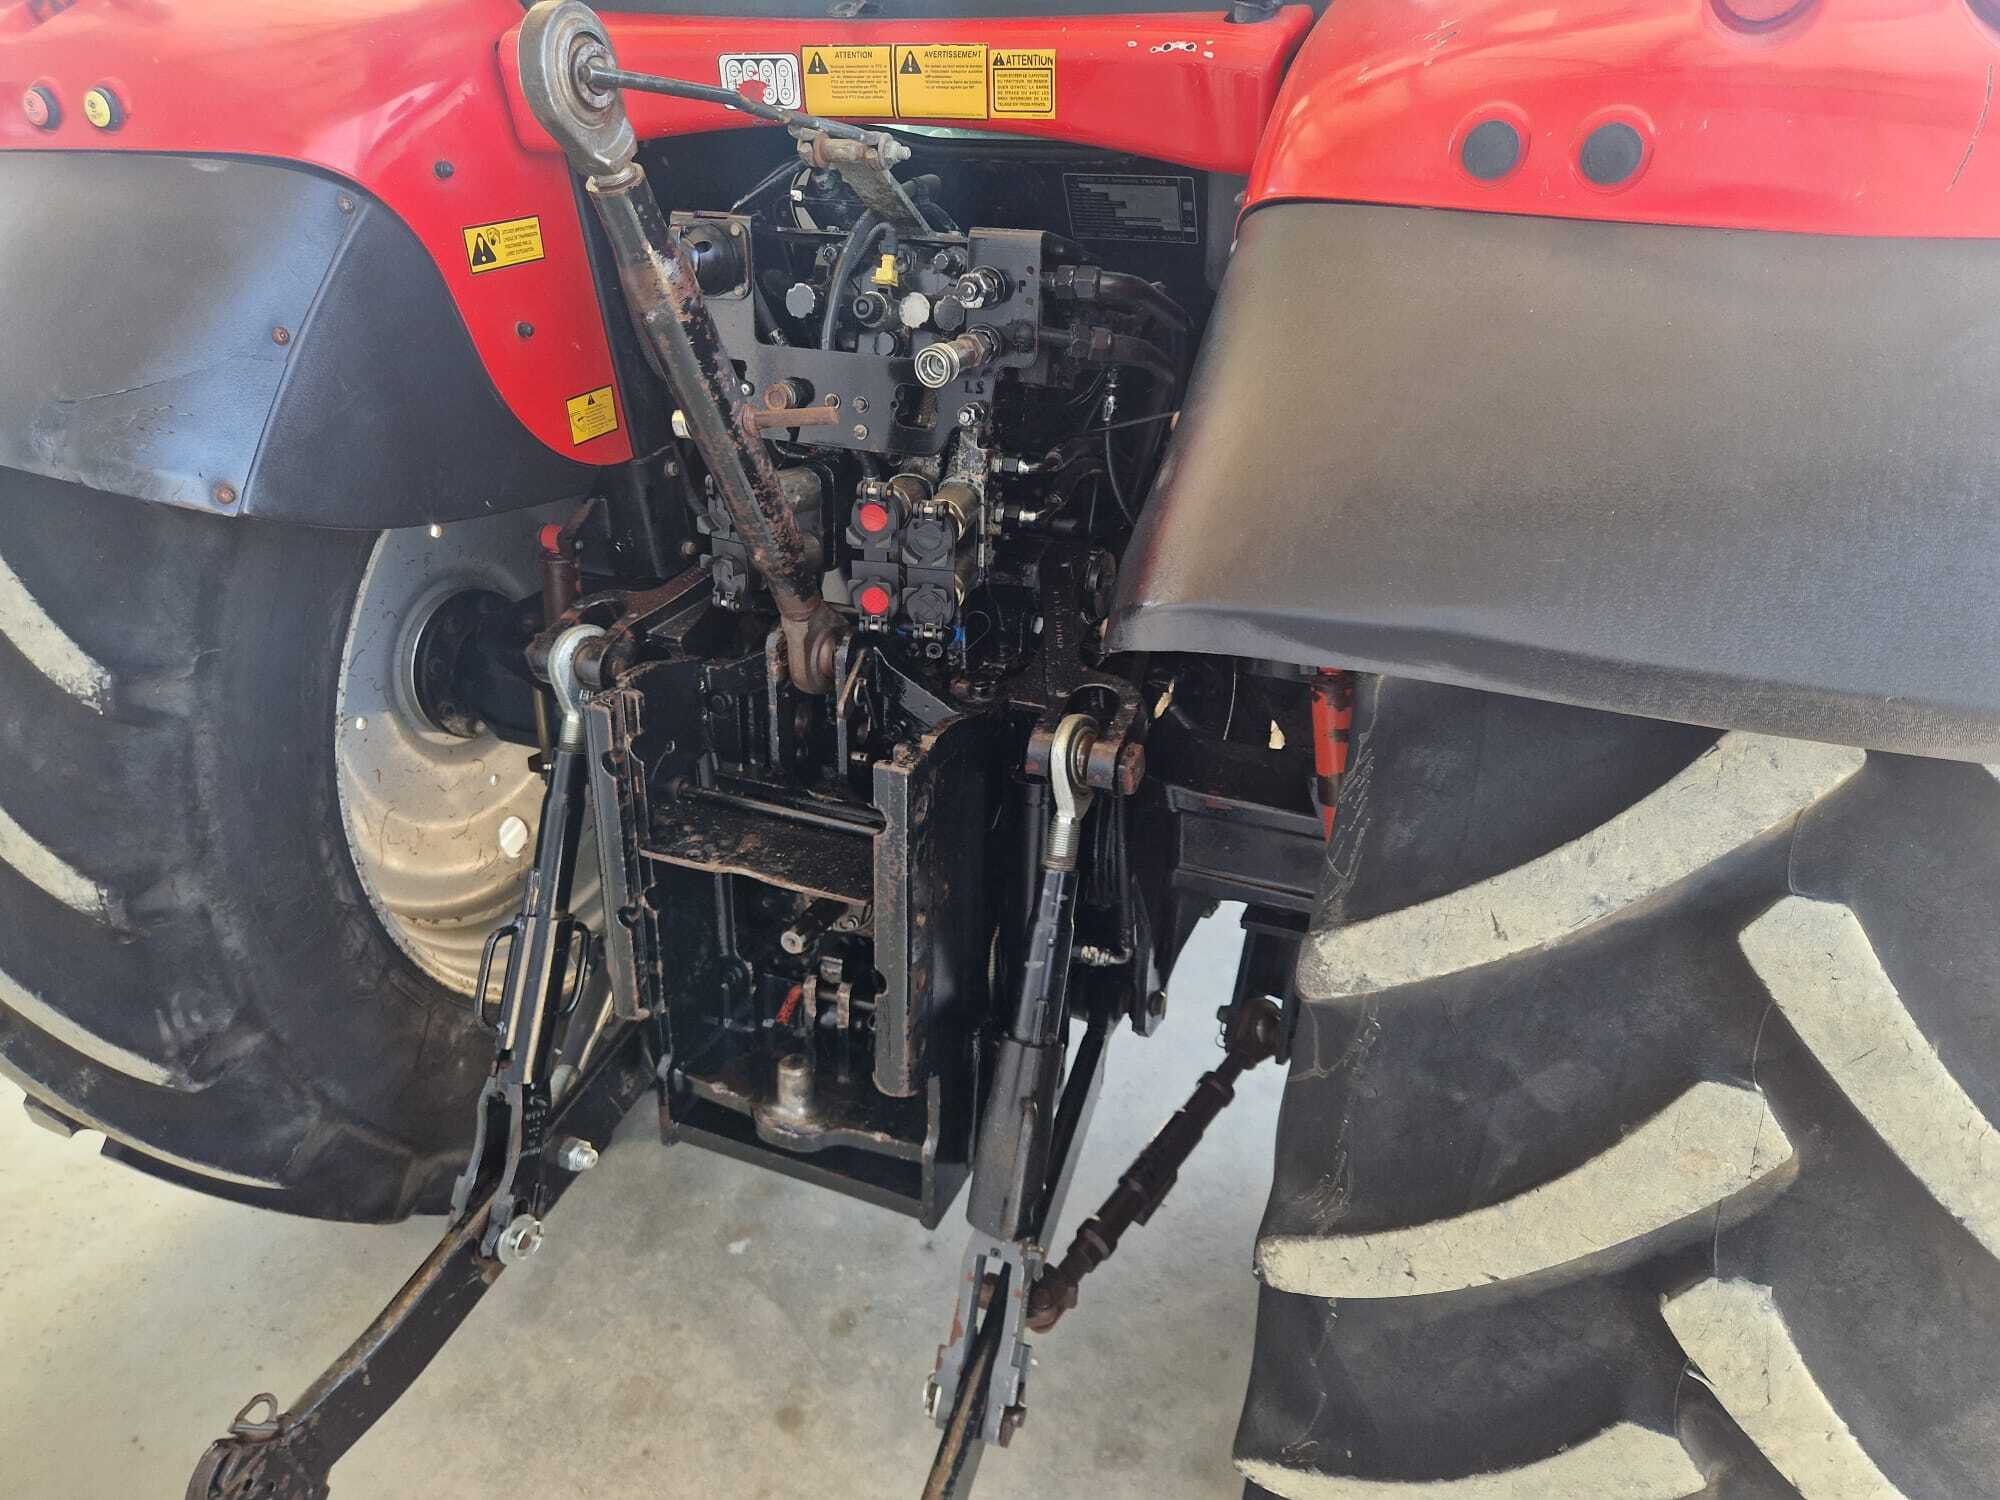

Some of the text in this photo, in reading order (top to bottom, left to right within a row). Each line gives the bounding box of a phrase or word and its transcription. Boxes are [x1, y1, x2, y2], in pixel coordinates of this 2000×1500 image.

[835, 51, 873, 59] ATTENTION
[924, 50, 981, 58] AVERTISSEMENT
[1006, 54, 1054, 66] ATTENTION
[1018, 279, 1026, 293] P
